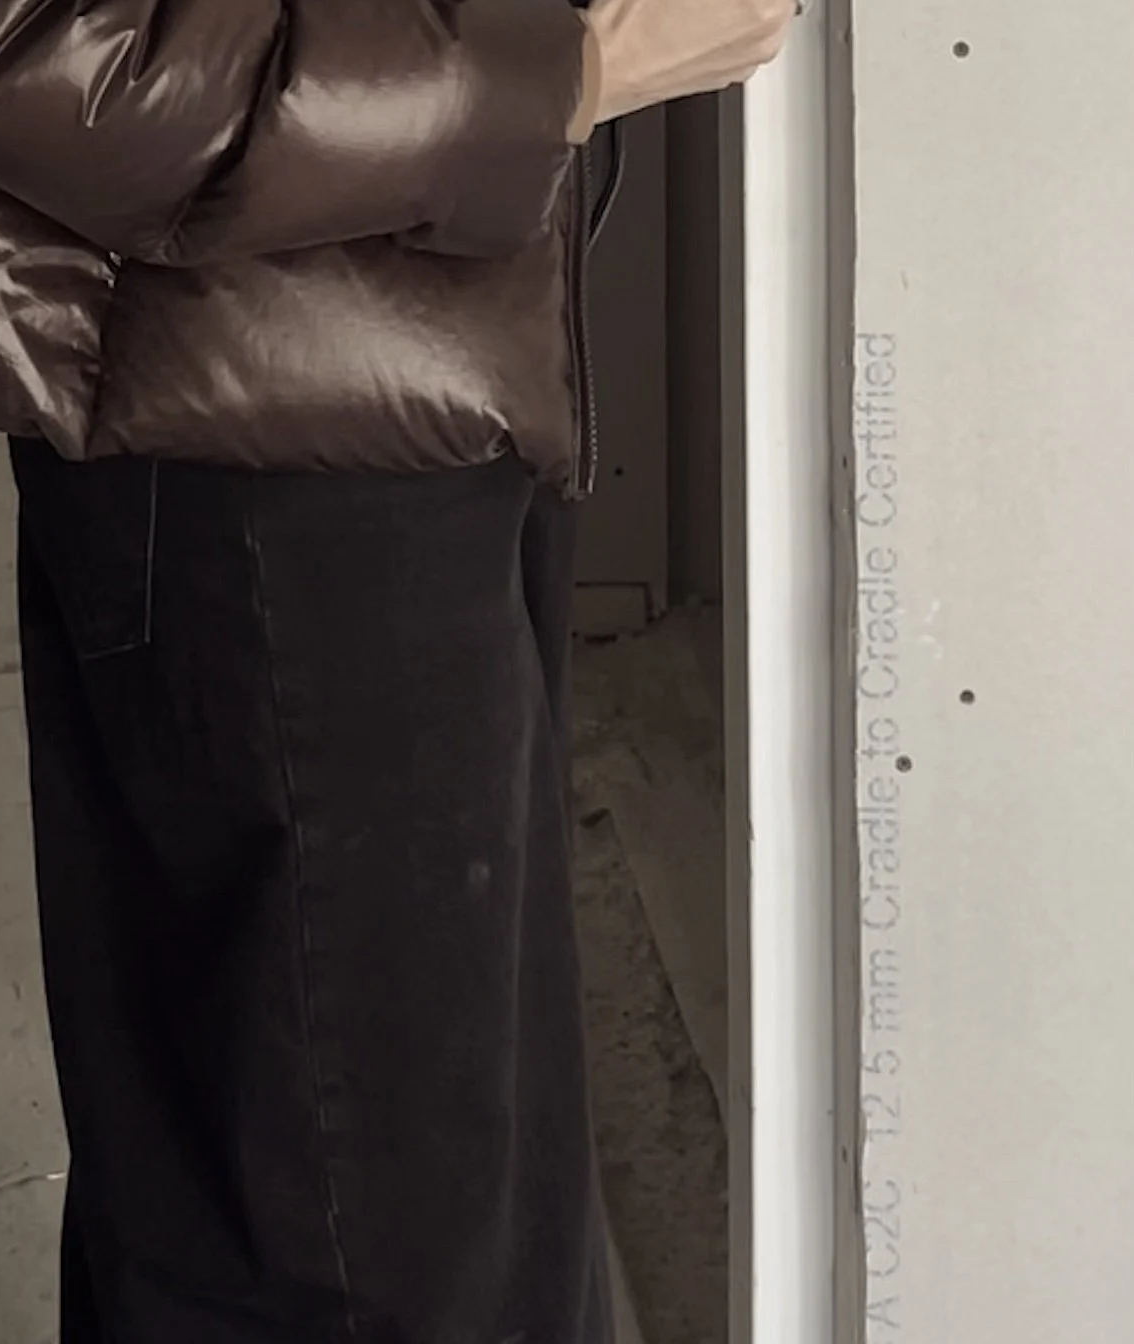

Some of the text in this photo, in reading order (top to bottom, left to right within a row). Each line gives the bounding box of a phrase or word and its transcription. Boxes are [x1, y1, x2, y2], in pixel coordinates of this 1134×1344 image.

[856, 332, 897, 527] Certified
[858, 546, 899, 699] Cradle
[861, 716, 900, 759] to
[859, 774, 900, 931] Cradle
[869, 948, 900, 1033] mm
[864, 1178, 901, 1279] C2C
